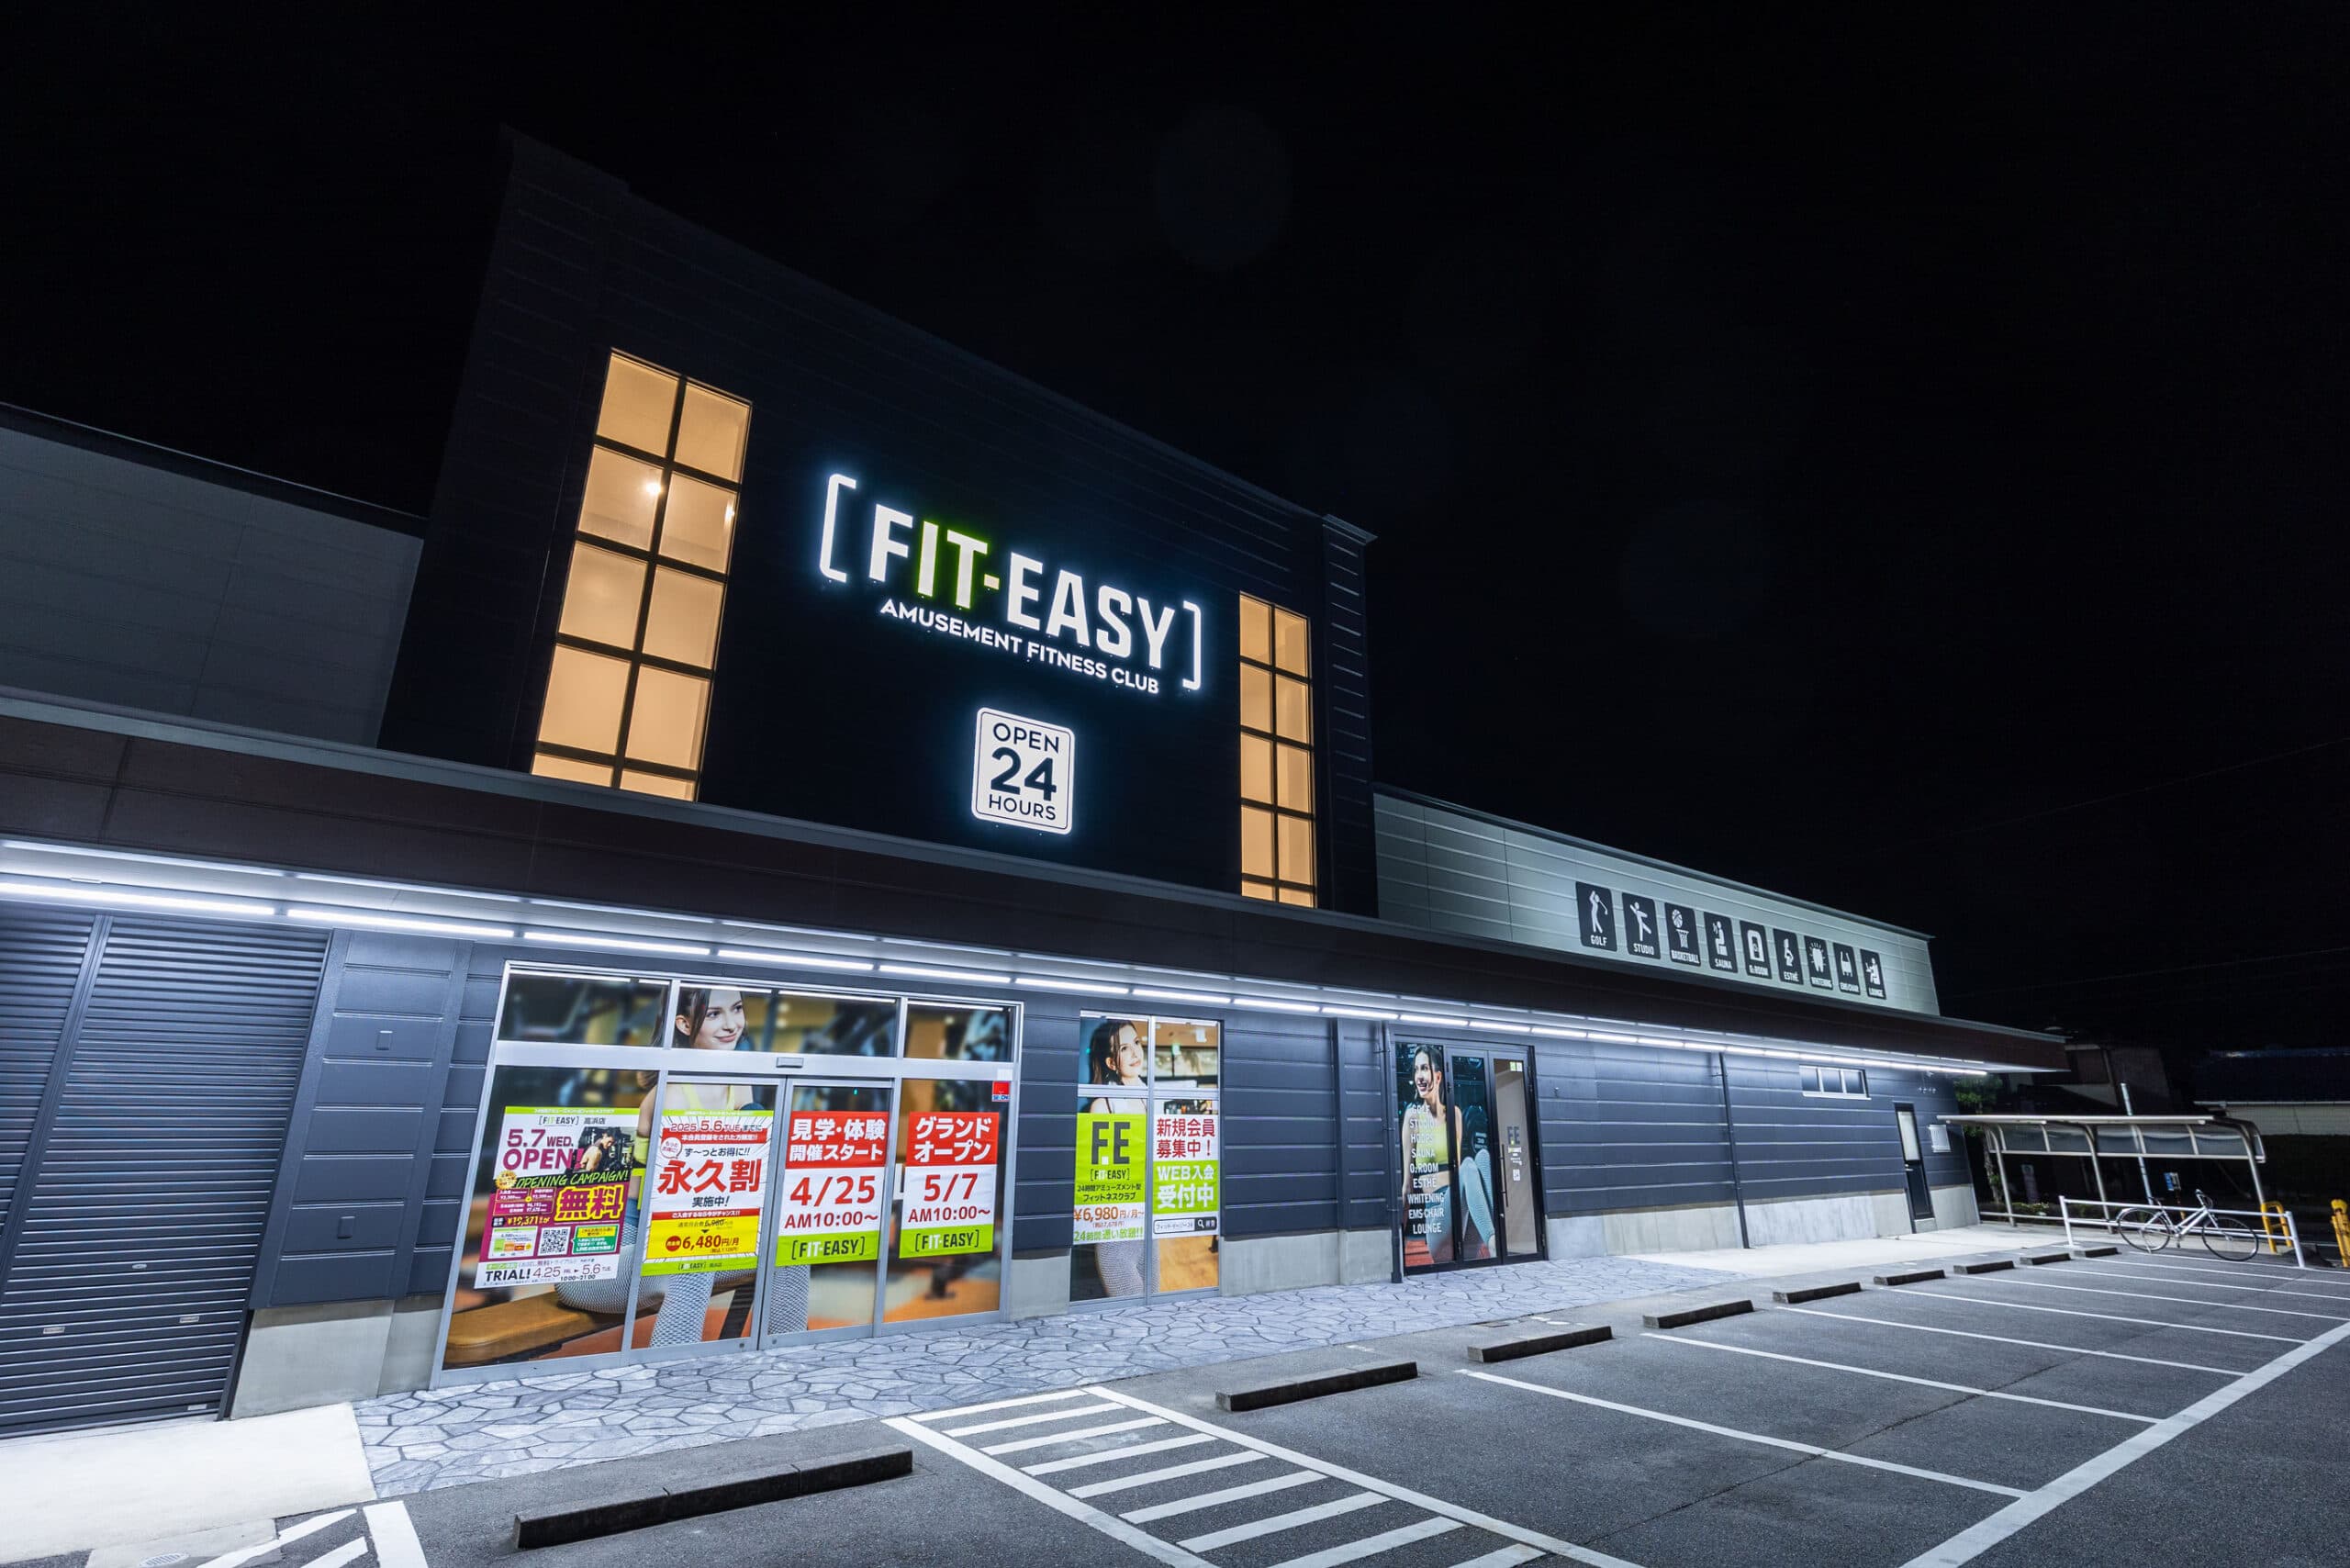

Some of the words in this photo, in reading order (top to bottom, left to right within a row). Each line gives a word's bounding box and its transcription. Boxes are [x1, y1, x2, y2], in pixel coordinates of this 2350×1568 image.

[879, 599, 1023, 655] AMUSEMENT
[1027, 641, 1107, 679] FITNESS
[1111, 667, 1159, 694] CLUB
[992, 722, 1059, 754] OPEN
[990, 747, 1057, 801] 24
[988, 793, 1057, 821] HOURS
[1590, 934, 1607, 946] GOLF
[1633, 943, 1654, 956] STUDIO
[507, 1128, 546, 1148] 5.7
[546, 1136, 574, 1147] WED.
[790, 1118, 886, 1141] 見学・体験
[915, 1116, 992, 1139] グランド
[1157, 1118, 1215, 1137] 新規会員
[502, 1148, 585, 1170] OPEN!
[789, 1144, 883, 1162] 開催スタート
[914, 1139, 991, 1163] オープン
[1157, 1139, 1211, 1159] 募集中!
[515, 1176, 566, 1189] OPENING
[569, 1170, 629, 1186] CAMPAIGN!
[657, 1159, 762, 1194] 永久割
[1157, 1165, 1214, 1182] WEB入会
[789, 1175, 877, 1207] 4/25
[923, 1173, 979, 1202] 5/7
[1158, 1183, 1214, 1209] 受付中
[1407, 1193, 1445, 1204] WHITENING
[555, 1184, 624, 1221] 無料
[691, 1195, 730, 1208] 実施中!
[1413, 1222, 1442, 1235] LOUNGE
[486, 1269, 531, 1282] TRIAL!
[532, 1266, 561, 1278] 4.25
[582, 1263, 601, 1275] 5.6
